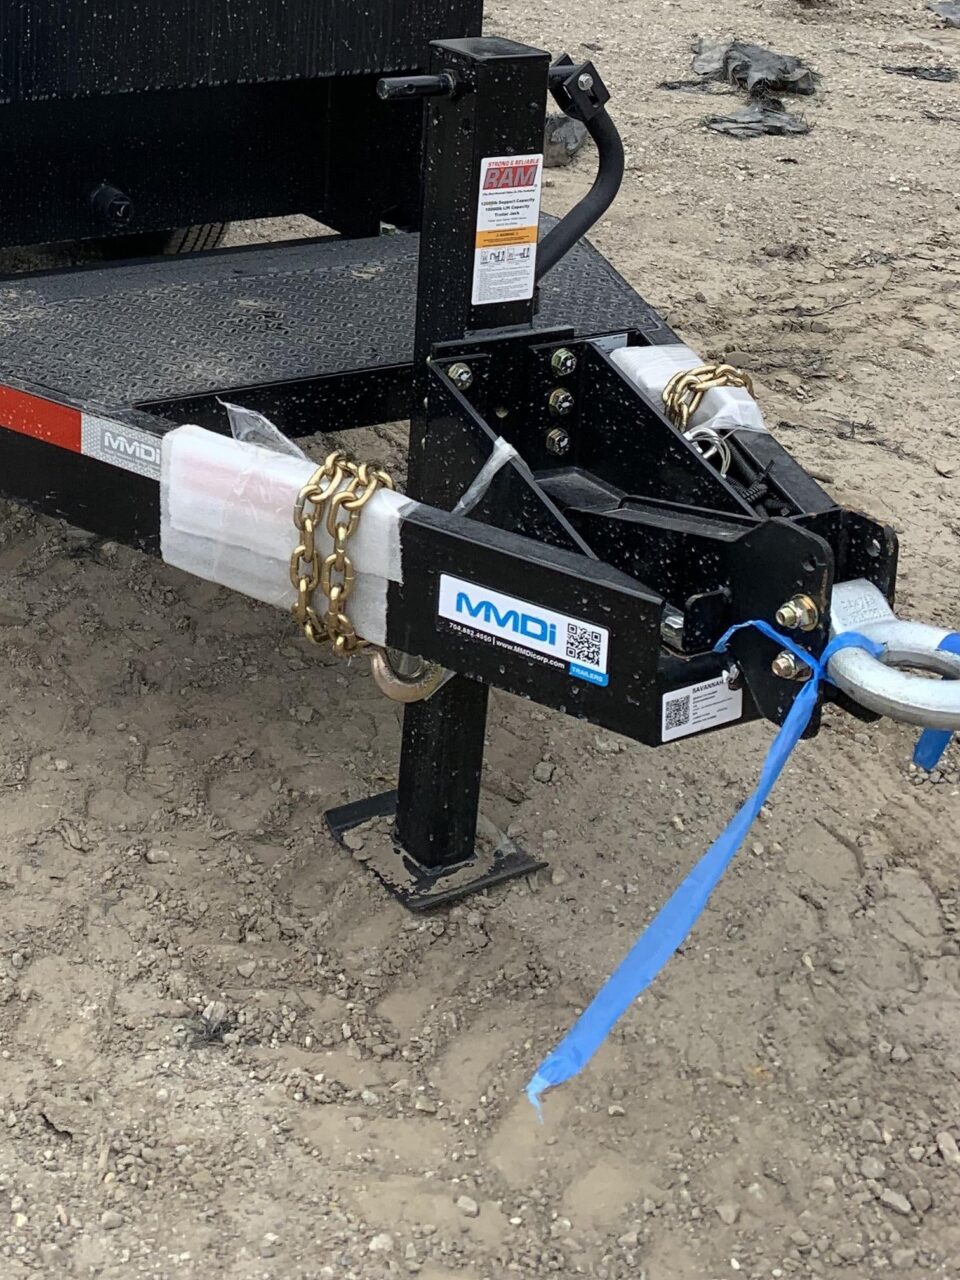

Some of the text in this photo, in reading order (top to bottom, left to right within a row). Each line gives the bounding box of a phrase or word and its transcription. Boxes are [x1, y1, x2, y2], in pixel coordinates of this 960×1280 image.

[483, 165, 538, 190] RAM
[455, 592, 557, 646] MMDi
[496, 640, 566, 670] www.MMDicorp.com
[571, 666, 604, 683] TRAILERS
[692, 679, 724, 694] SAVANNAH
